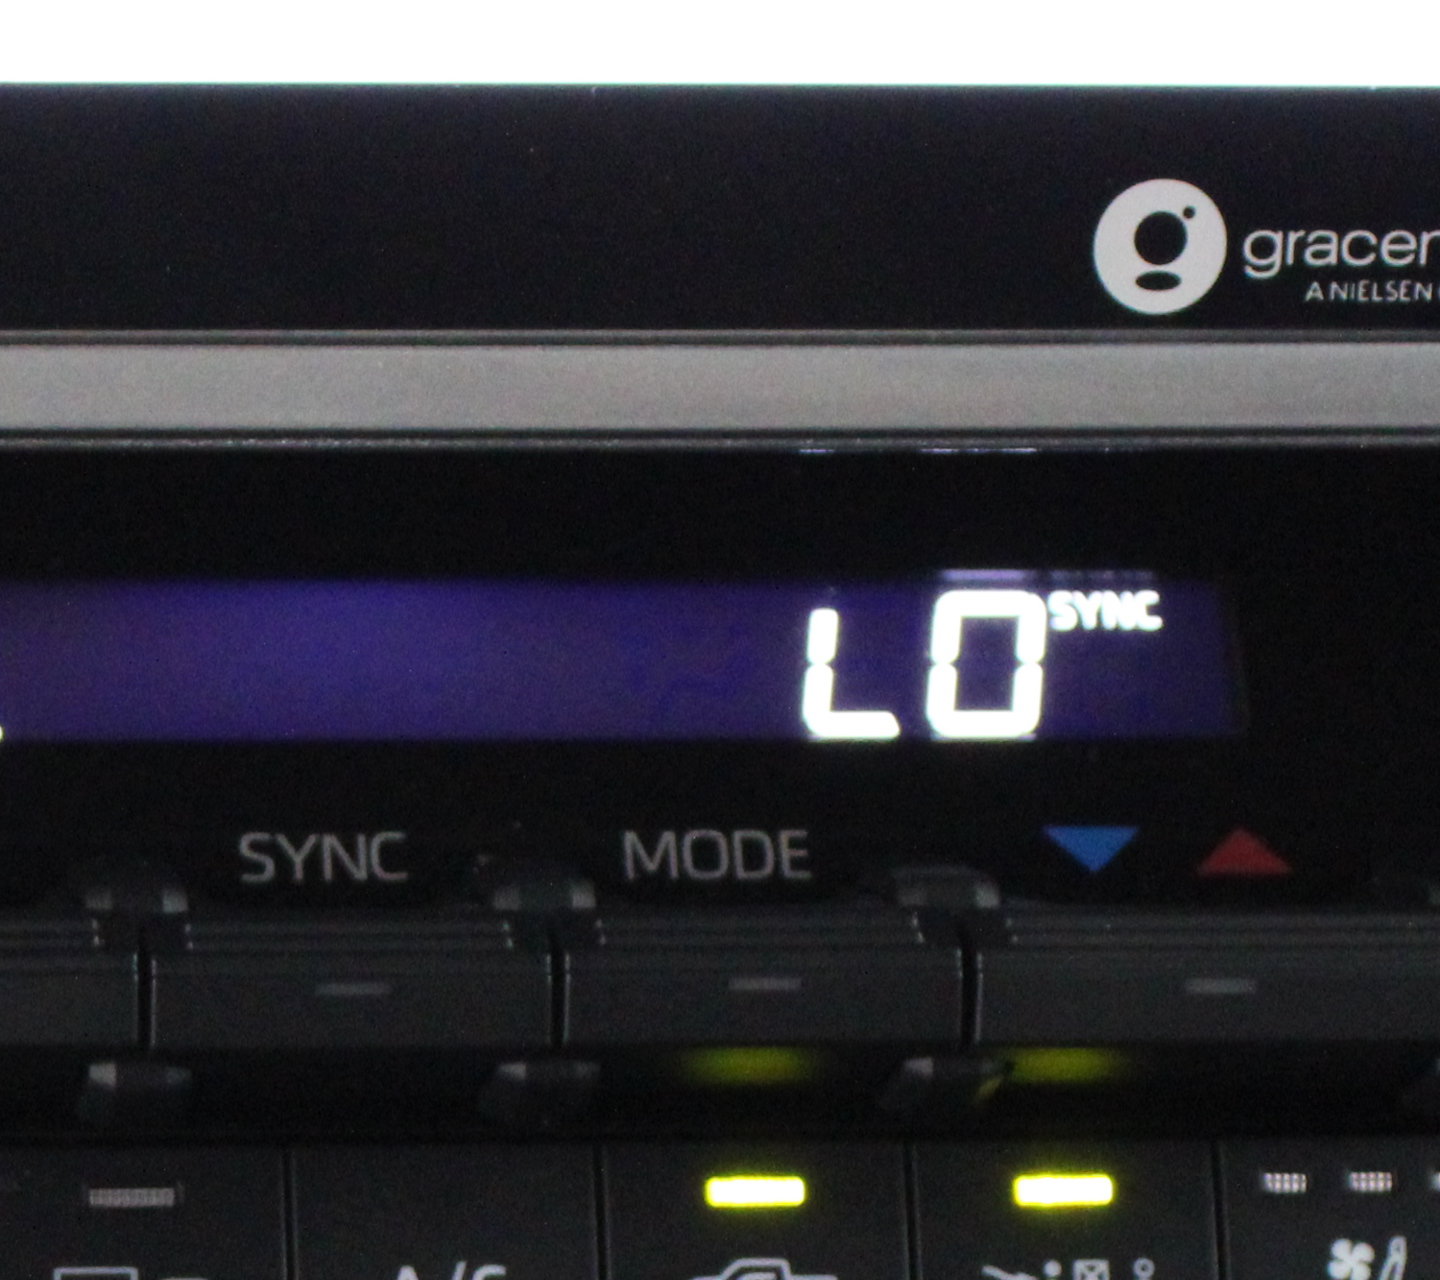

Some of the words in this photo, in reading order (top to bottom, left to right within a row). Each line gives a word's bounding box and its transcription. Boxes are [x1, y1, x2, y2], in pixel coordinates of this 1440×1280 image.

[1305, 281, 1324, 302] A
[1330, 280, 1433, 302] NIELSEN
[1046, 589, 1164, 632] SYNC
[238, 830, 407, 883] SYNC
[622, 828, 811, 880] MODE
